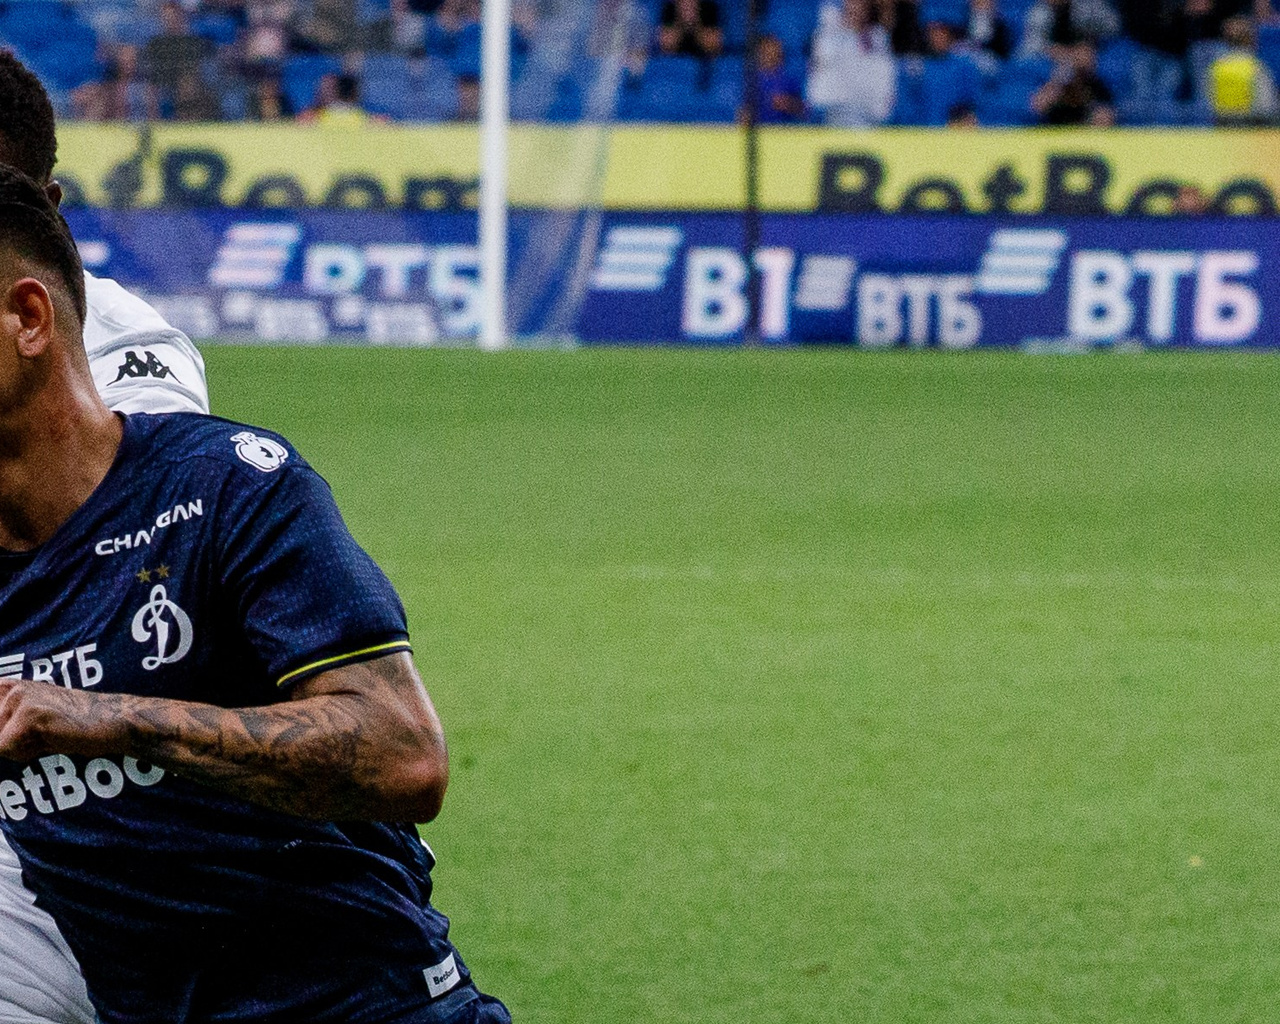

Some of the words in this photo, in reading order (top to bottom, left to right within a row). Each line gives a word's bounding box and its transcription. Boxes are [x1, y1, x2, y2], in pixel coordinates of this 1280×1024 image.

[682, 246, 794, 340] ВТ
[856, 274, 984, 348] ВТБ
[1066, 249, 1263, 344] ВТБ
[95, 498, 203, 556] CHAGAN
[30, 642, 104, 690] ВТБ
